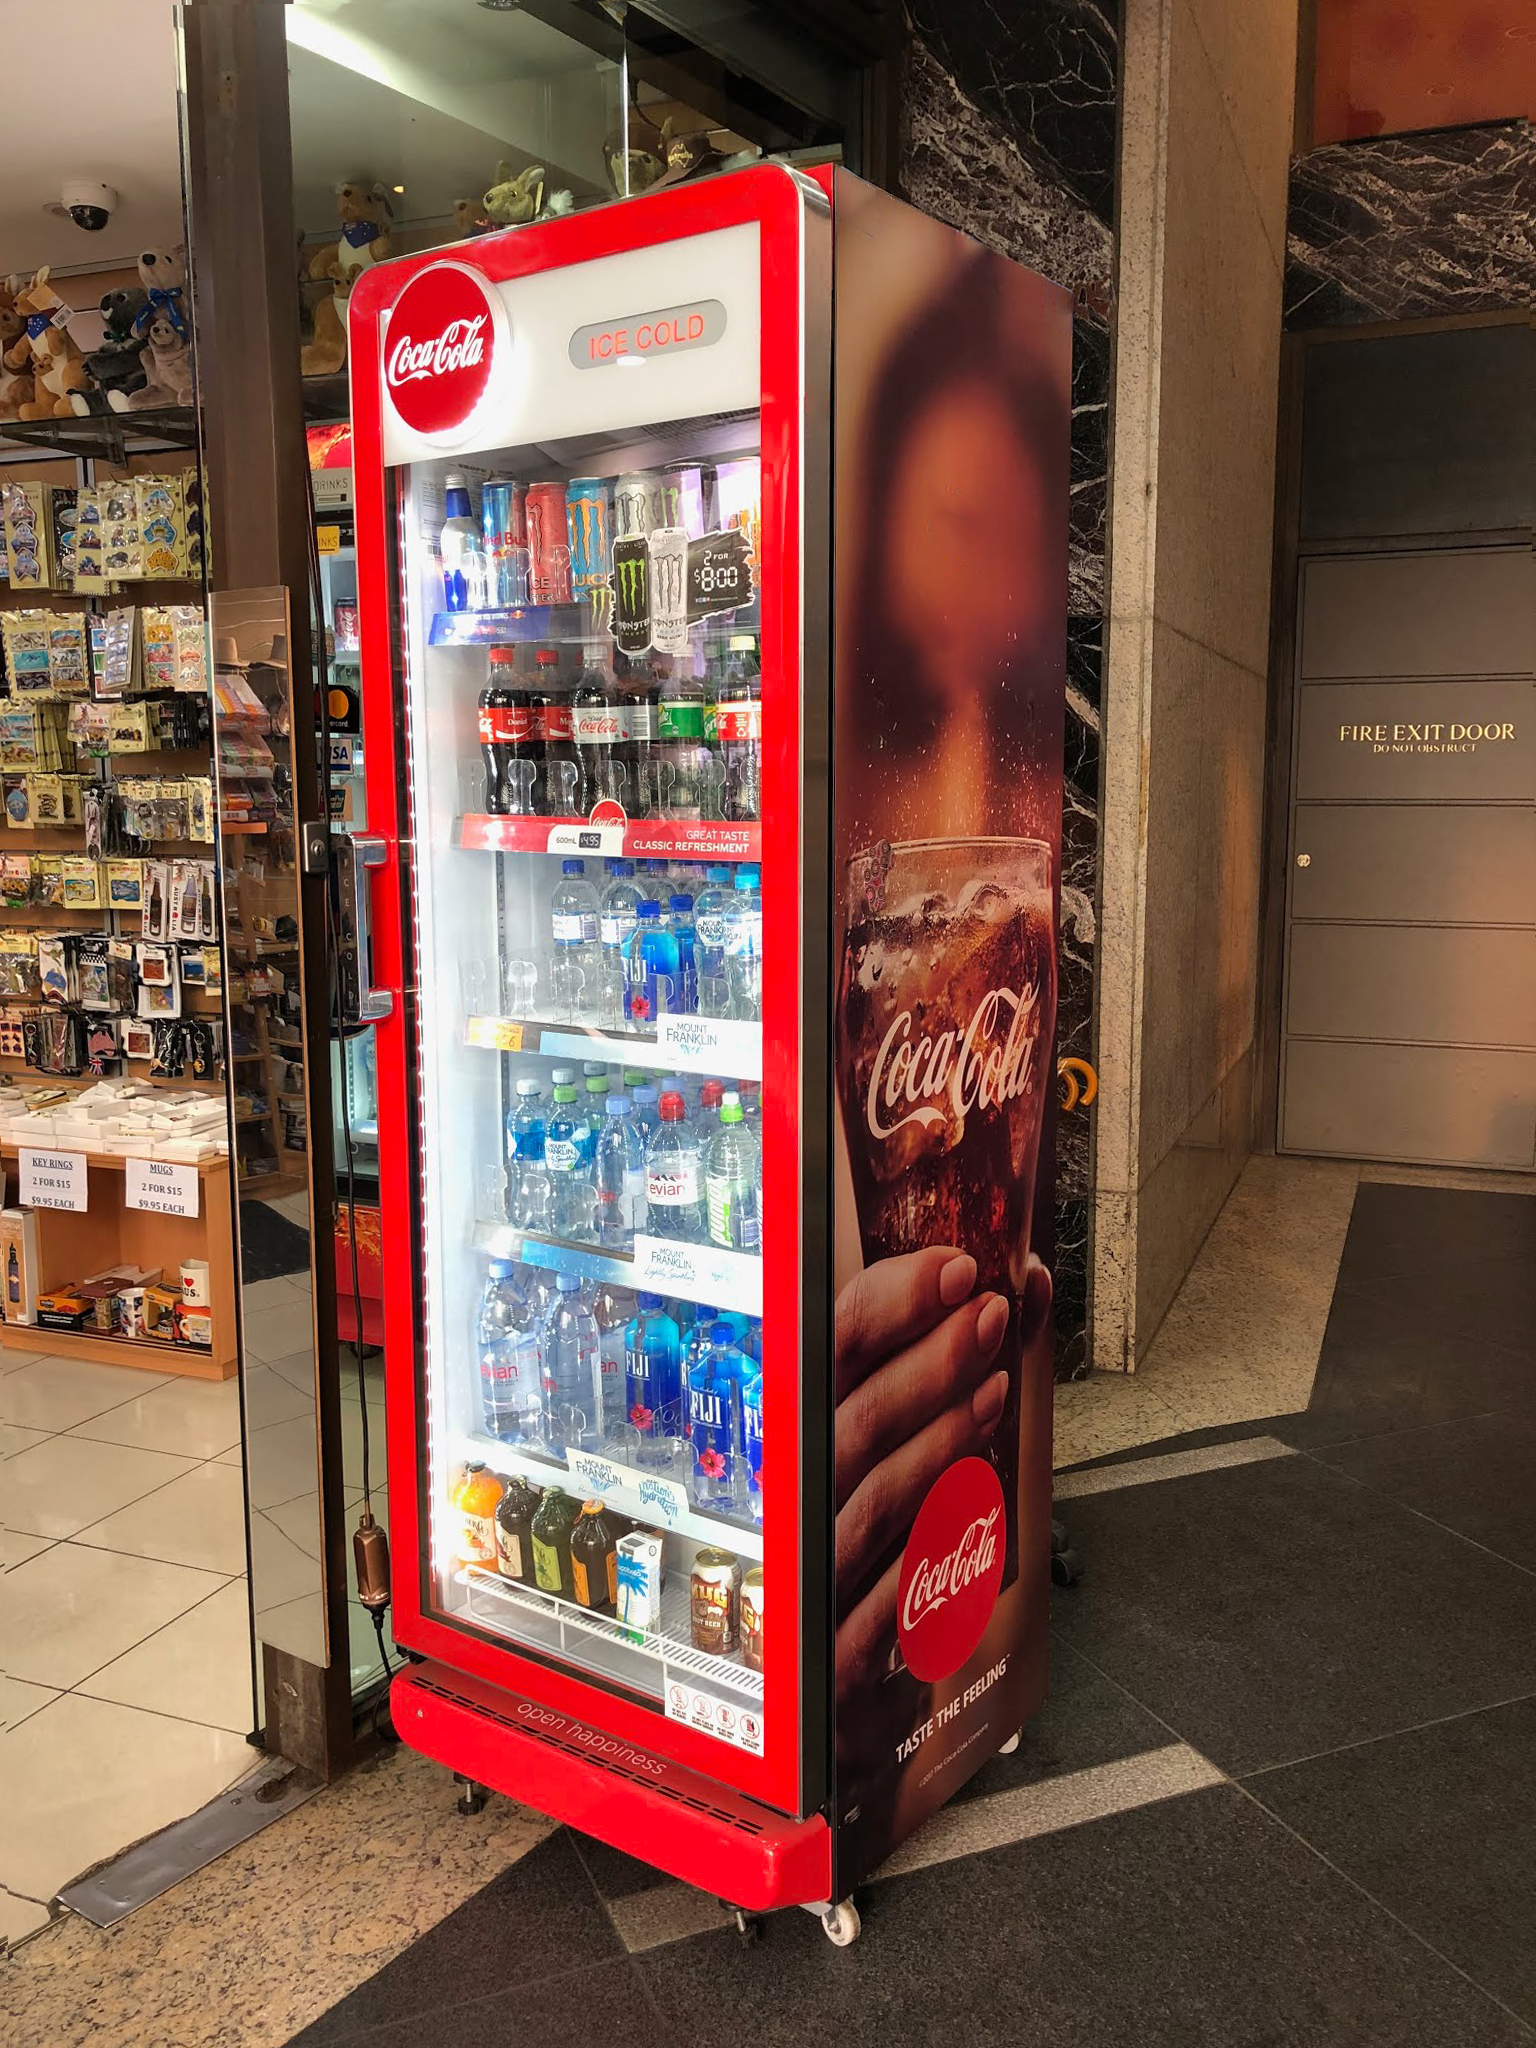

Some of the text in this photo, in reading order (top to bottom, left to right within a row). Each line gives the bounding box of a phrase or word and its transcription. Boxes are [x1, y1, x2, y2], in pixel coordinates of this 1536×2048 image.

[589, 314, 705, 360] ICE COLD
[388, 313, 487, 386] Coca-Cola
[313, 478, 348, 492] DRINKS
[318, 537, 338, 547] INKS
[703, 550, 712, 566] 2
[693, 566, 738, 592] $8.00
[578, 717, 620, 734] Coca-Cola
[1339, 723, 1516, 741] FIRE EXIT DOOR
[330, 746, 349, 761] ISA
[1373, 743, 1478, 753] DO NOT OBSTRUCT
[556, 834, 600, 847] 600mL $4.95
[686, 830, 750, 842] GREAT TASTE
[633, 840, 750, 854] CLASSIC REFRESHMENT
[676, 1022, 708, 1034] MOUNT
[666, 1028, 718, 1046] FRANKLIN
[867, 980, 1041, 1140] Coca-Cola
[32, 1157, 74, 1171] KEY RINGS
[149, 1163, 174, 1176] MUGS
[32, 1176, 71, 1189] 2 FOR $15
[141, 1182, 183, 1196] 2 FOR $15
[649, 1183, 685, 1196] evian
[31, 1196, 75, 1210] $9.95 EACH
[138, 1198, 185, 1214] $9.95 EACH
[651, 1251, 692, 1269] FRANKLIN
[659, 1248, 684, 1258] MOUNT
[626, 1351, 650, 1378] FIJI
[690, 1390, 722, 1425] FIJI
[576, 1461, 623, 1486] FRANKLIN
[584, 1459, 612, 1474] MOUNT
[903, 1504, 1001, 1631] Coca-Cola
[704, 1619, 723, 1628] BEER
[895, 1656, 1008, 1763] TASTE THE FEELING
[517, 1703, 567, 1730] open
[566, 1723, 668, 1775] happiness
[967, 1722, 989, 1744] Company
